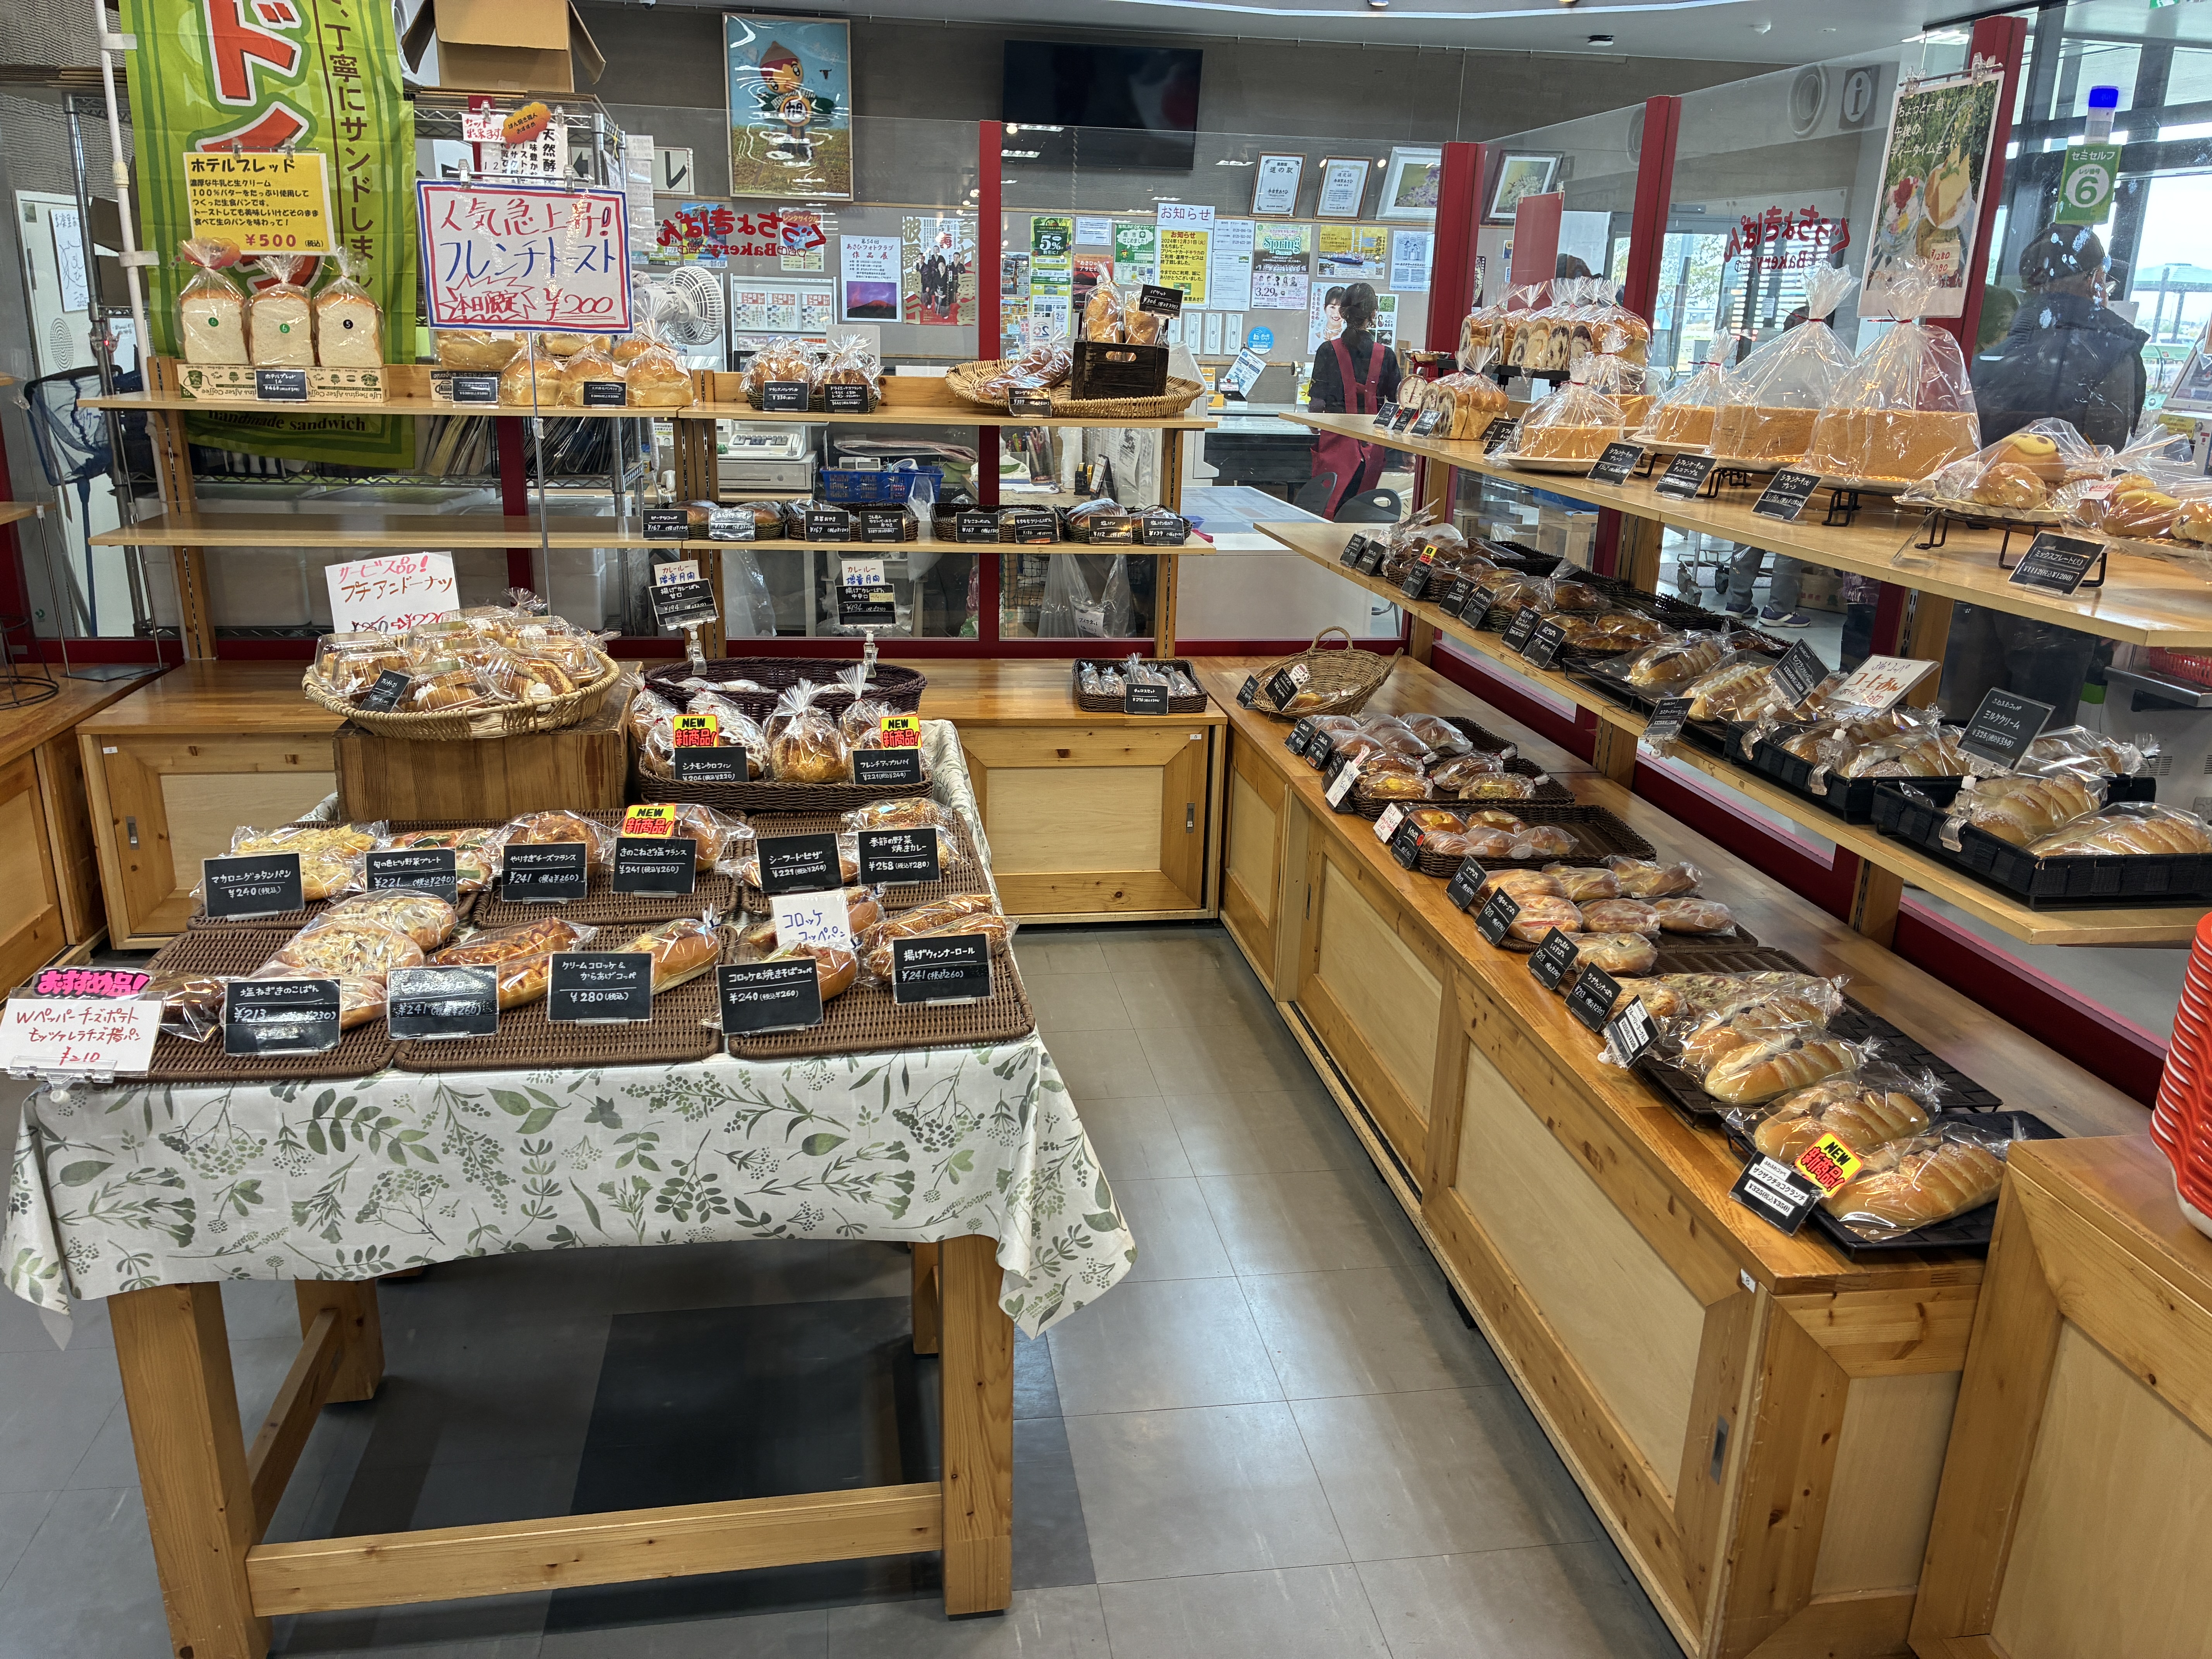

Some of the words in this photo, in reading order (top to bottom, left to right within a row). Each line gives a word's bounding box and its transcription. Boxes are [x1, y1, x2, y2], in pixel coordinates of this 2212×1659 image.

[1898, 97, 1945, 117] ちょっと一息
[517, 123, 536, 134] おすすめ
[1894, 124, 1921, 139] 午後の
[2071, 150, 2116, 160] セミセルフ
[191, 158, 295, 173] ホテルブレッド
[192, 189, 309, 198] 100%バターをたっぷり使用して
[2074, 176, 2098, 205] 6
[194, 208, 319, 217] トーストしても美味しいけどそのまま
[440, 198, 612, 238] 人気急上昇!
[1161, 206, 1211, 221] お知らせ
[245, 234, 296, 247] ¥500
[1262, 235, 1301, 254] Spring
[440, 237, 617, 282] フレンチトースト
[852, 251, 889, 259] 作品展
[1255, 287, 1276, 297] 3.29
[454, 290, 521, 315] 本日限定
[543, 287, 614, 322] ¥200
[290, 416, 366, 431] sandwich
[338, 555, 428, 584] サービス品!
[663, 565, 689, 574] カレールー
[659, 572, 695, 584] 増量月間
[846, 574, 880, 585] 増量月間
[341, 575, 452, 603] プチアンドーナツ
[660, 584, 700, 595] 揚げカレーぱん
[682, 718, 706, 728] NEW
[888, 719, 909, 729] NEW
[1983, 710, 2020, 730] ミルククリーム
[675, 729, 716, 747] 新商品!
[882, 730, 921, 747] 新商品!
[682, 761, 732, 771] シナモンクロフィン
[860, 759, 910, 769] フレンチアップルパイ
[636, 808, 664, 817] NEW
[626, 818, 673, 834] 新商品!
[869, 835, 913, 848] 季節の野菜
[620, 848, 687, 857] きのこねぎ塩フランス
[891, 844, 927, 853] 焼きカレー
[373, 857, 441, 868] 旬の色どり野菜プレート
[510, 854, 577, 864] やりすぎチーズフランス
[769, 850, 824, 864] シーフードピザ
[211, 870, 291, 883] マカロニグラタンパン
[508, 872, 532, 884] ¥241
[1455, 872, 1464, 884] ¥213
[1484, 905, 1494, 918] ¥213
[782, 910, 823, 929] コロッケ
[798, 926, 845, 941] コッペパン
[903, 946, 975, 961] 揚げウィンナーロール
[1535, 948, 1546, 962] ¥213
[562, 960, 626, 970] クリームコロッケ&
[580, 971, 637, 982] からあげコッペ
[729, 967, 812, 983] コロッケ&焼きそばコッペ
[37, 969, 151, 997] おすすめ品!
[240, 985, 319, 998] 塩ねぎきのこぱん
[570, 992, 629, 1003] ¥280(税込)
[1574, 984, 1586, 999] ¥213
[234, 1008, 268, 1022] ¥213
[1823, 1141, 1851, 1166] NEW
[1801, 1146, 1845, 1192] 新商品!
[1753, 1167, 1805, 1201] ザクザクチョコクランチ
[1749, 1183, 1791, 1213] ¥325(税込¥350)
